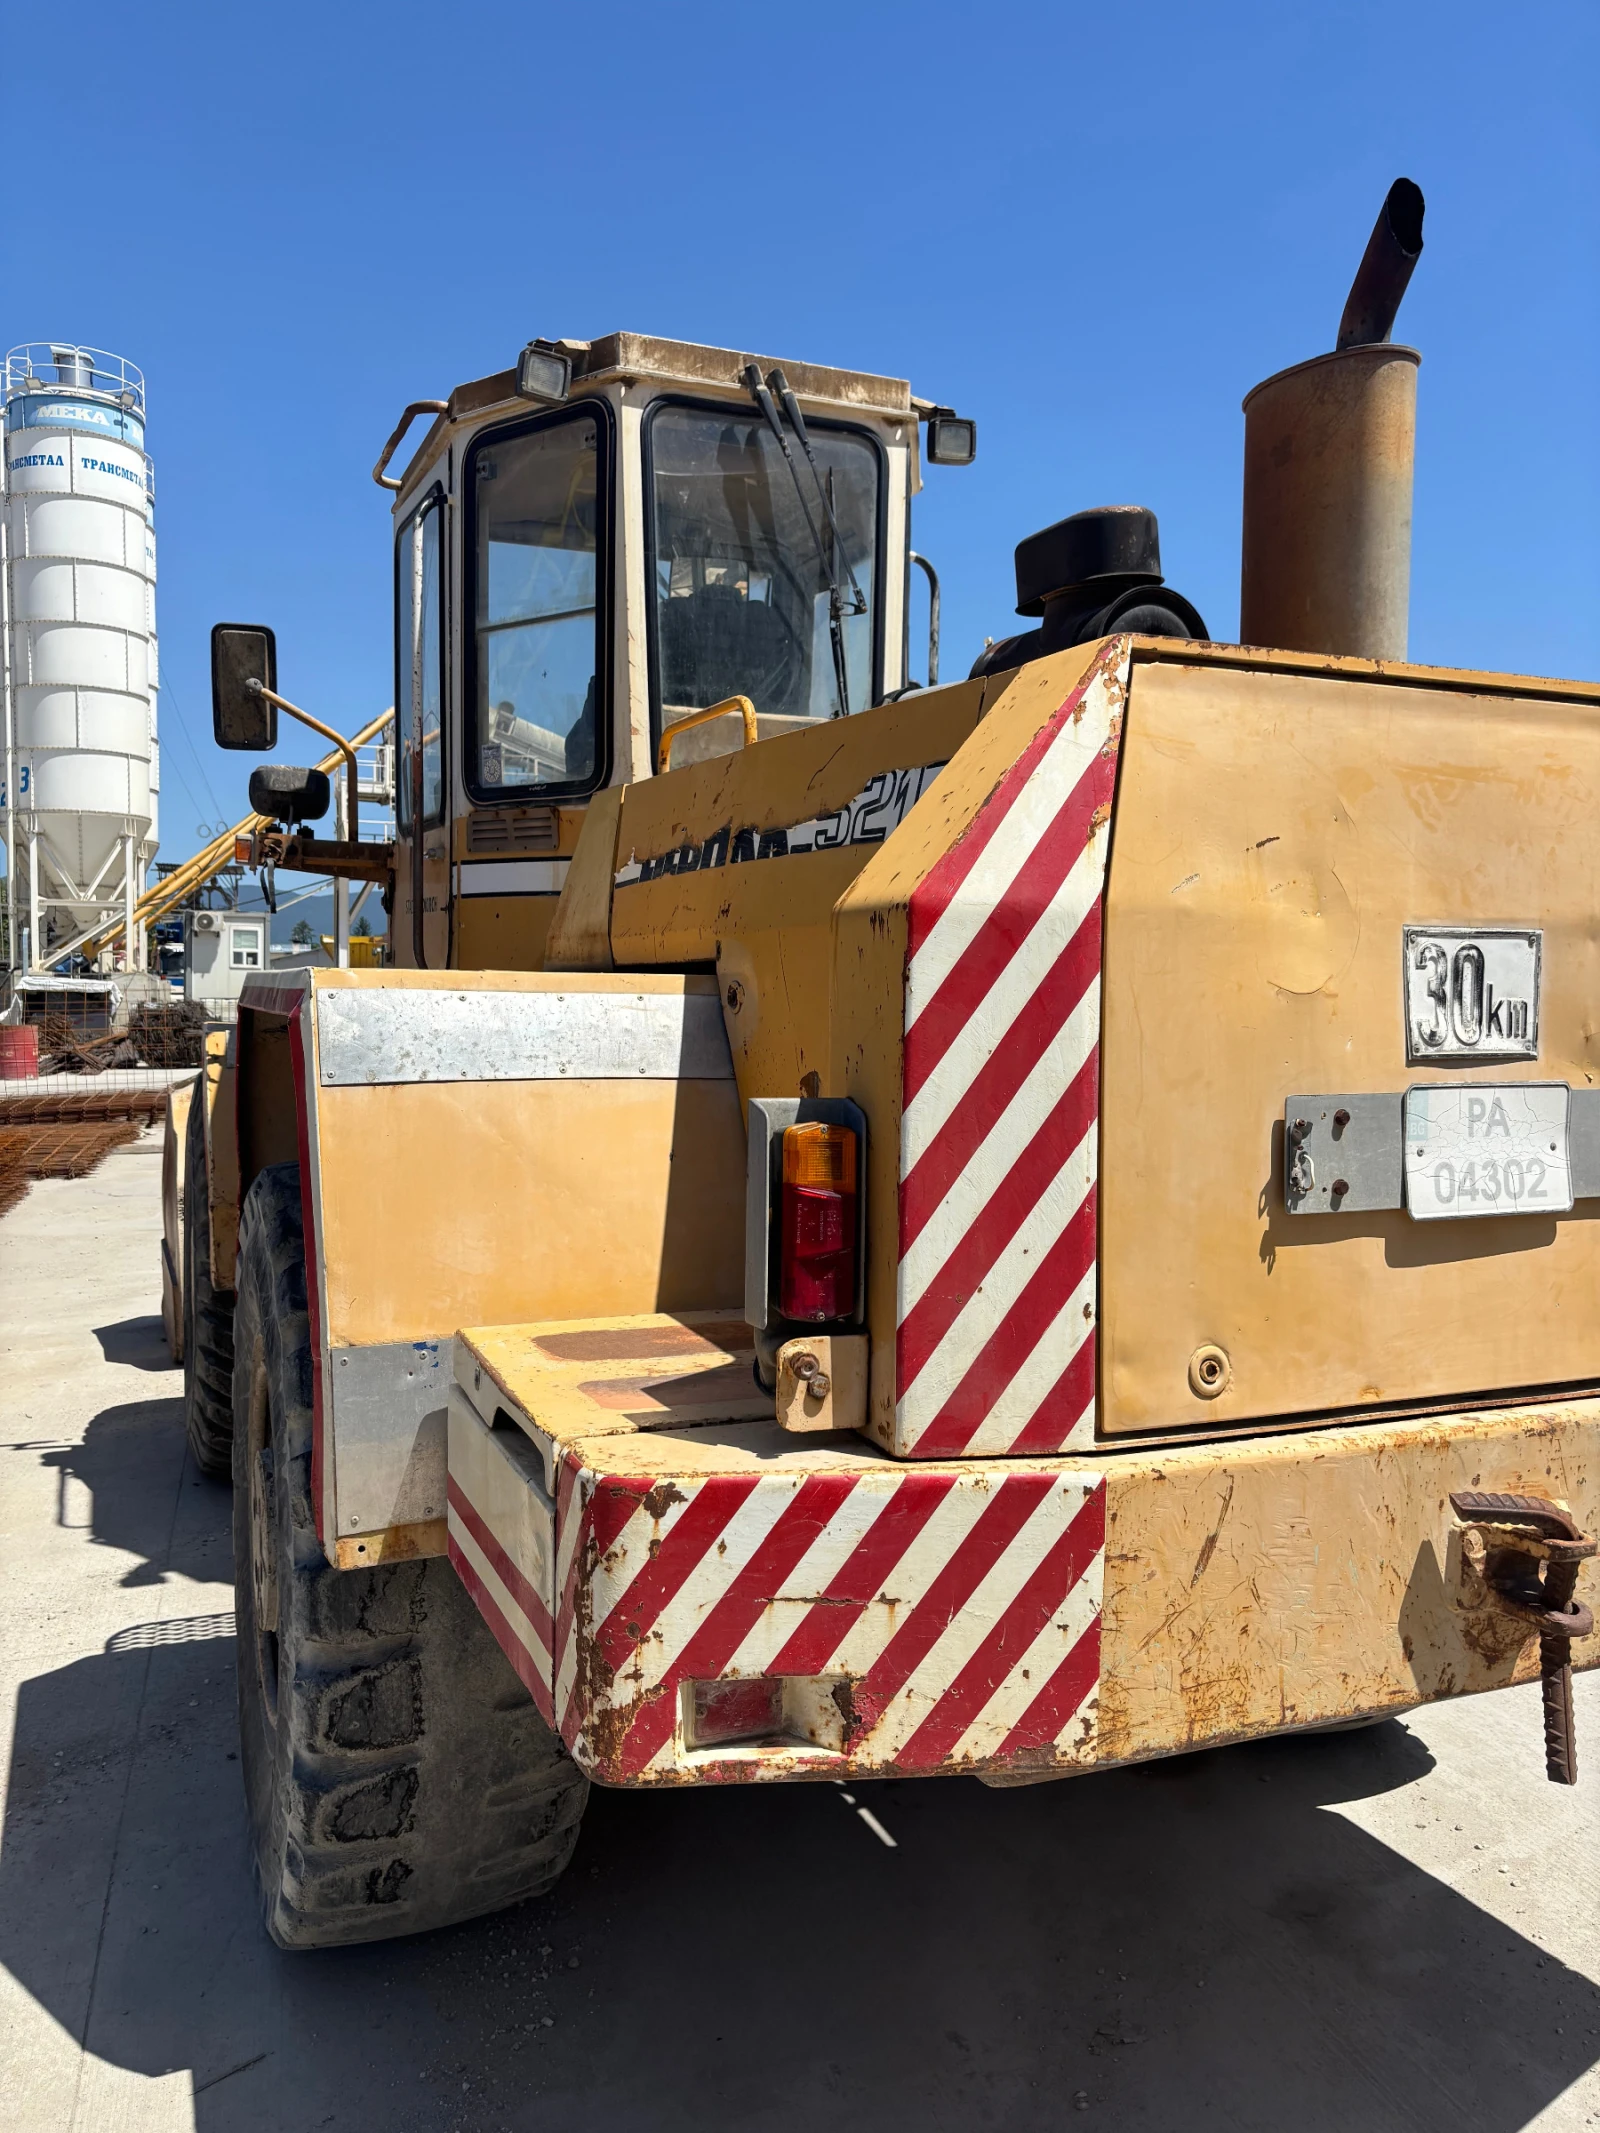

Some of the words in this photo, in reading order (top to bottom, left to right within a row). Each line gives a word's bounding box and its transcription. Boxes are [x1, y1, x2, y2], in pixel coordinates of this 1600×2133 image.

[37, 405, 109, 426] MEKA
[1410, 1122, 1425, 1136] BG
[1467, 1096, 1511, 1138] PA
[1433, 1158, 1548, 1205] 04302
